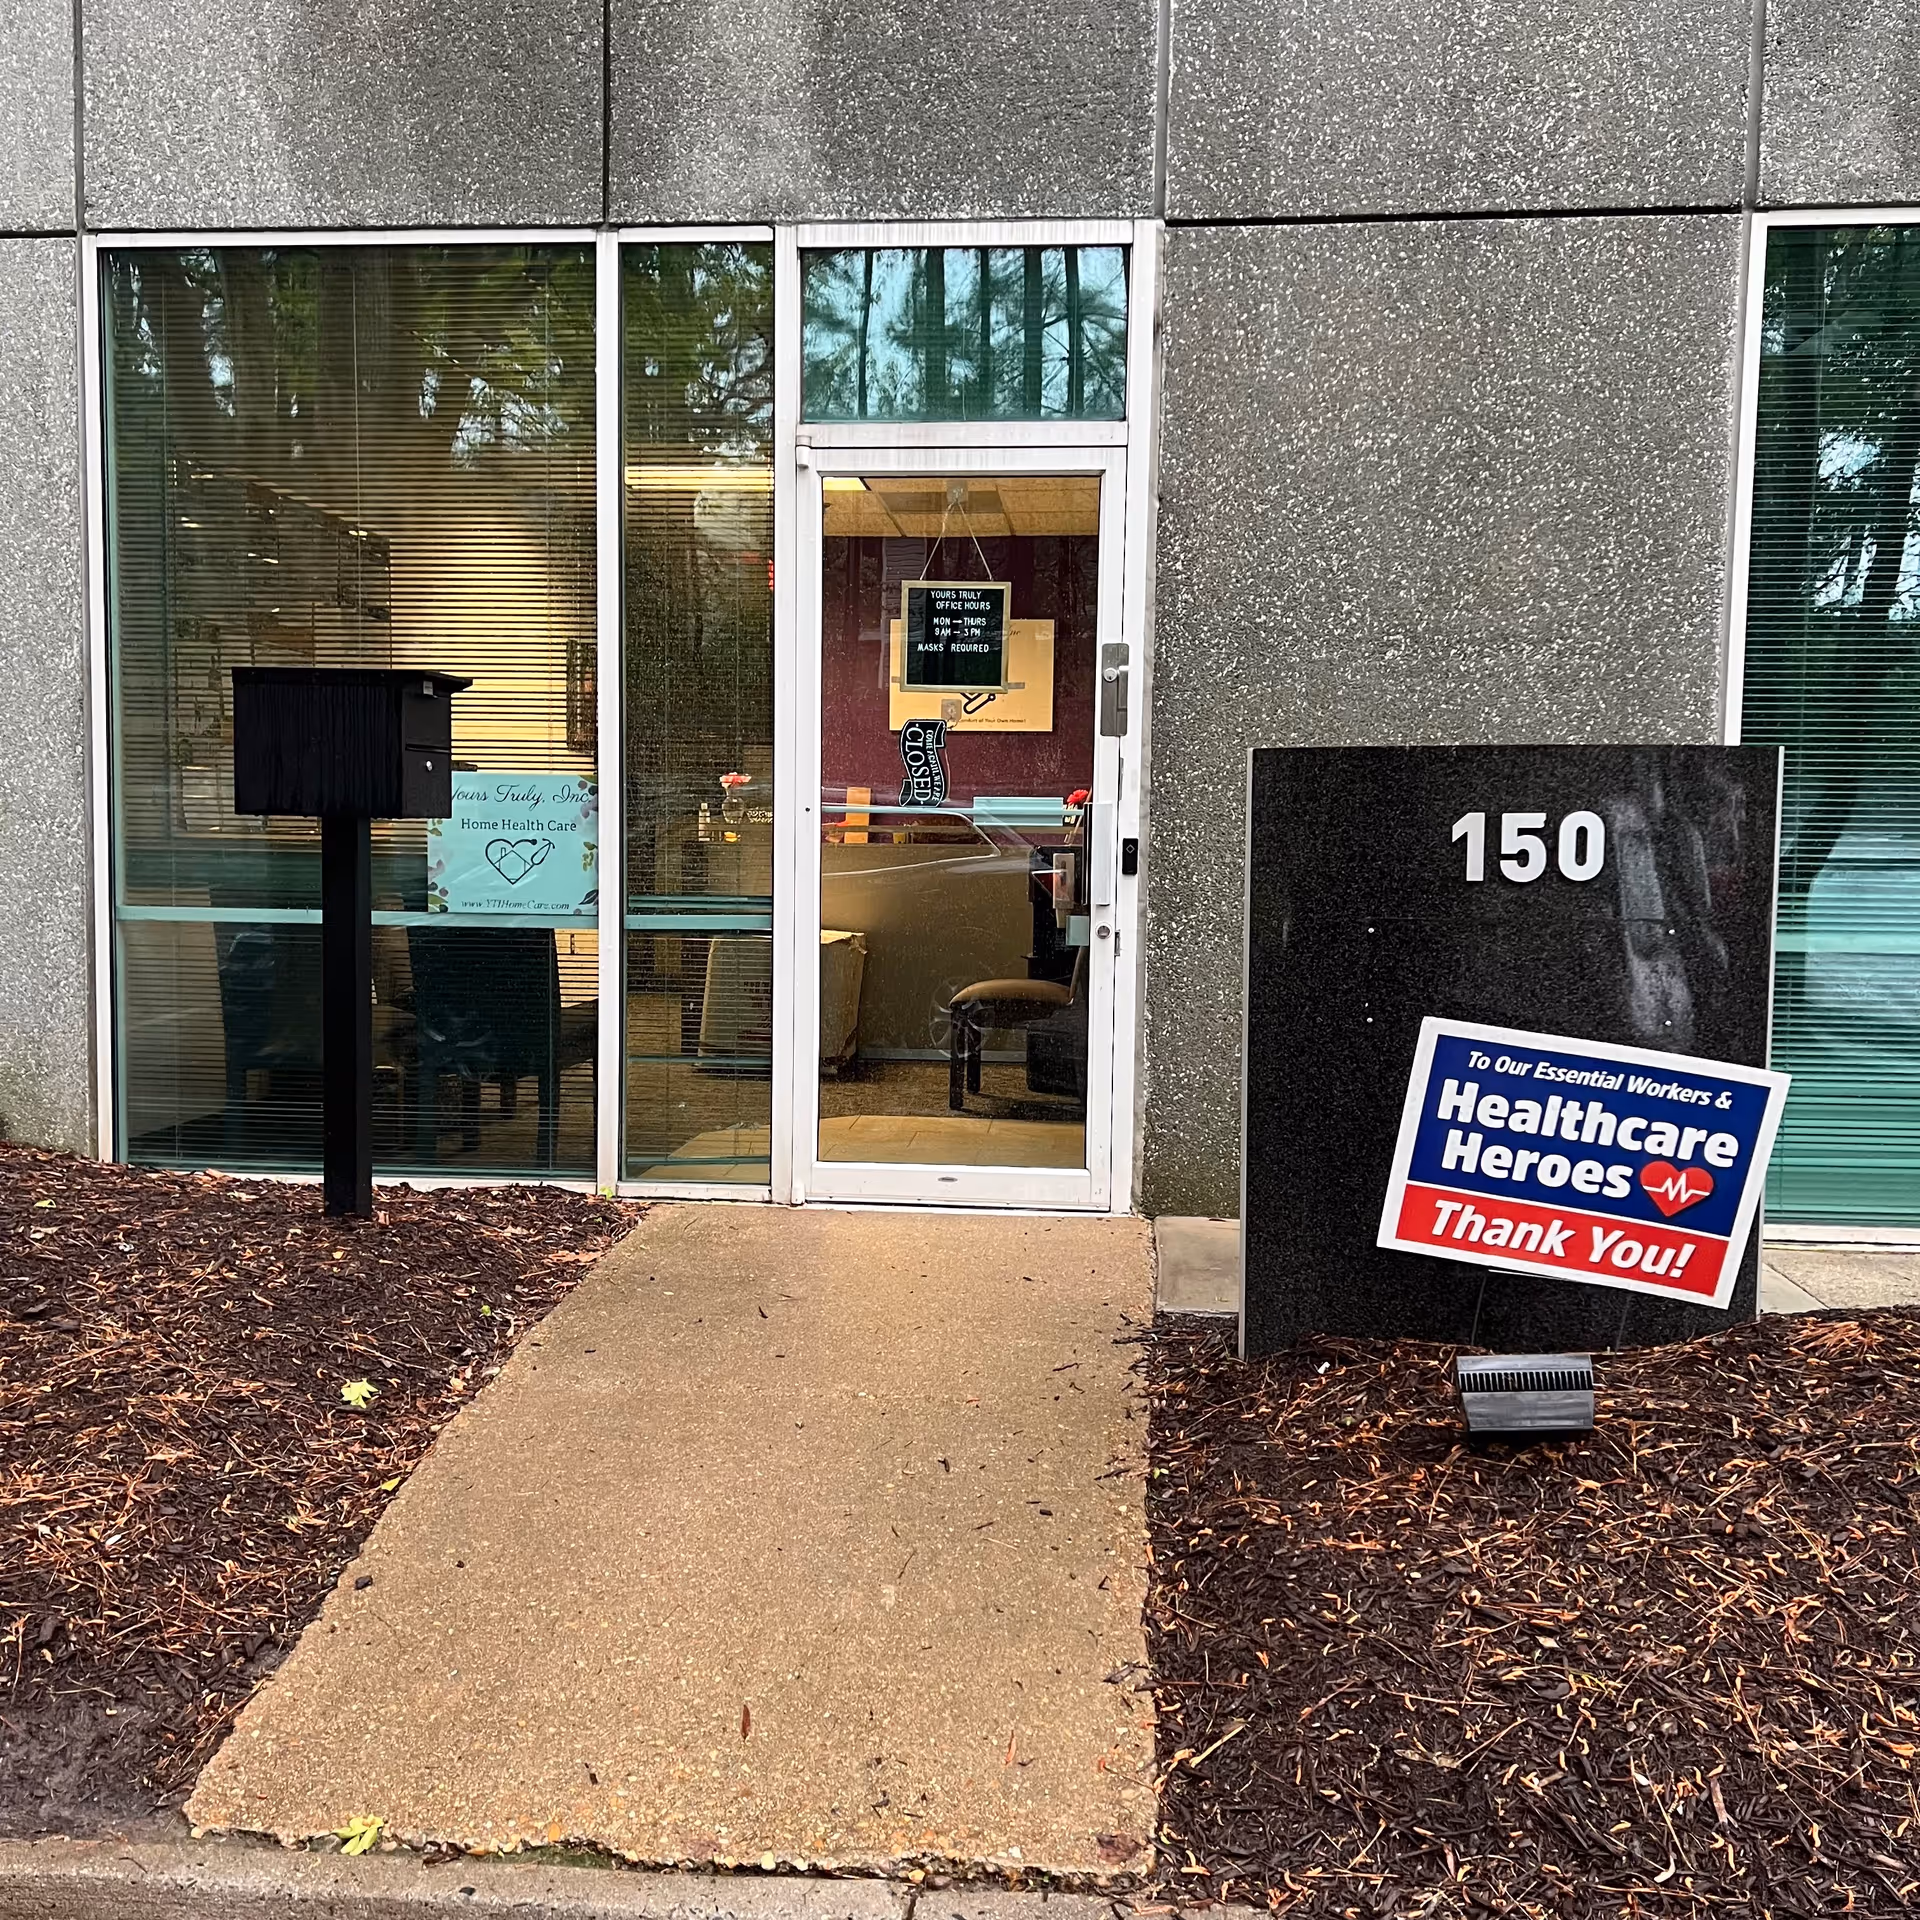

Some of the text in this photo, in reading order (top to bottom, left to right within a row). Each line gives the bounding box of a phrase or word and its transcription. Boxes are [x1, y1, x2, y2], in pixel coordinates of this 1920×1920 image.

[930, 590, 982, 600] YOURS TRULY
[933, 617, 951, 625] MON
[964, 618, 987, 626] THURS
[936, 601, 991, 610] OFFICE HOURS
[917, 643, 990, 653] MASKS REQUIRED
[905, 727, 932, 802] CLOSED
[461, 818, 577, 831] Home Health Care
[1452, 810, 1605, 883] 150
[1467, 1050, 1733, 1110] To Our Essential Workers &
[1437, 1078, 1739, 1168] Healthcare
[1441, 1128, 1634, 1199] Heroes
[1430, 1199, 1697, 1279] Thank You!
